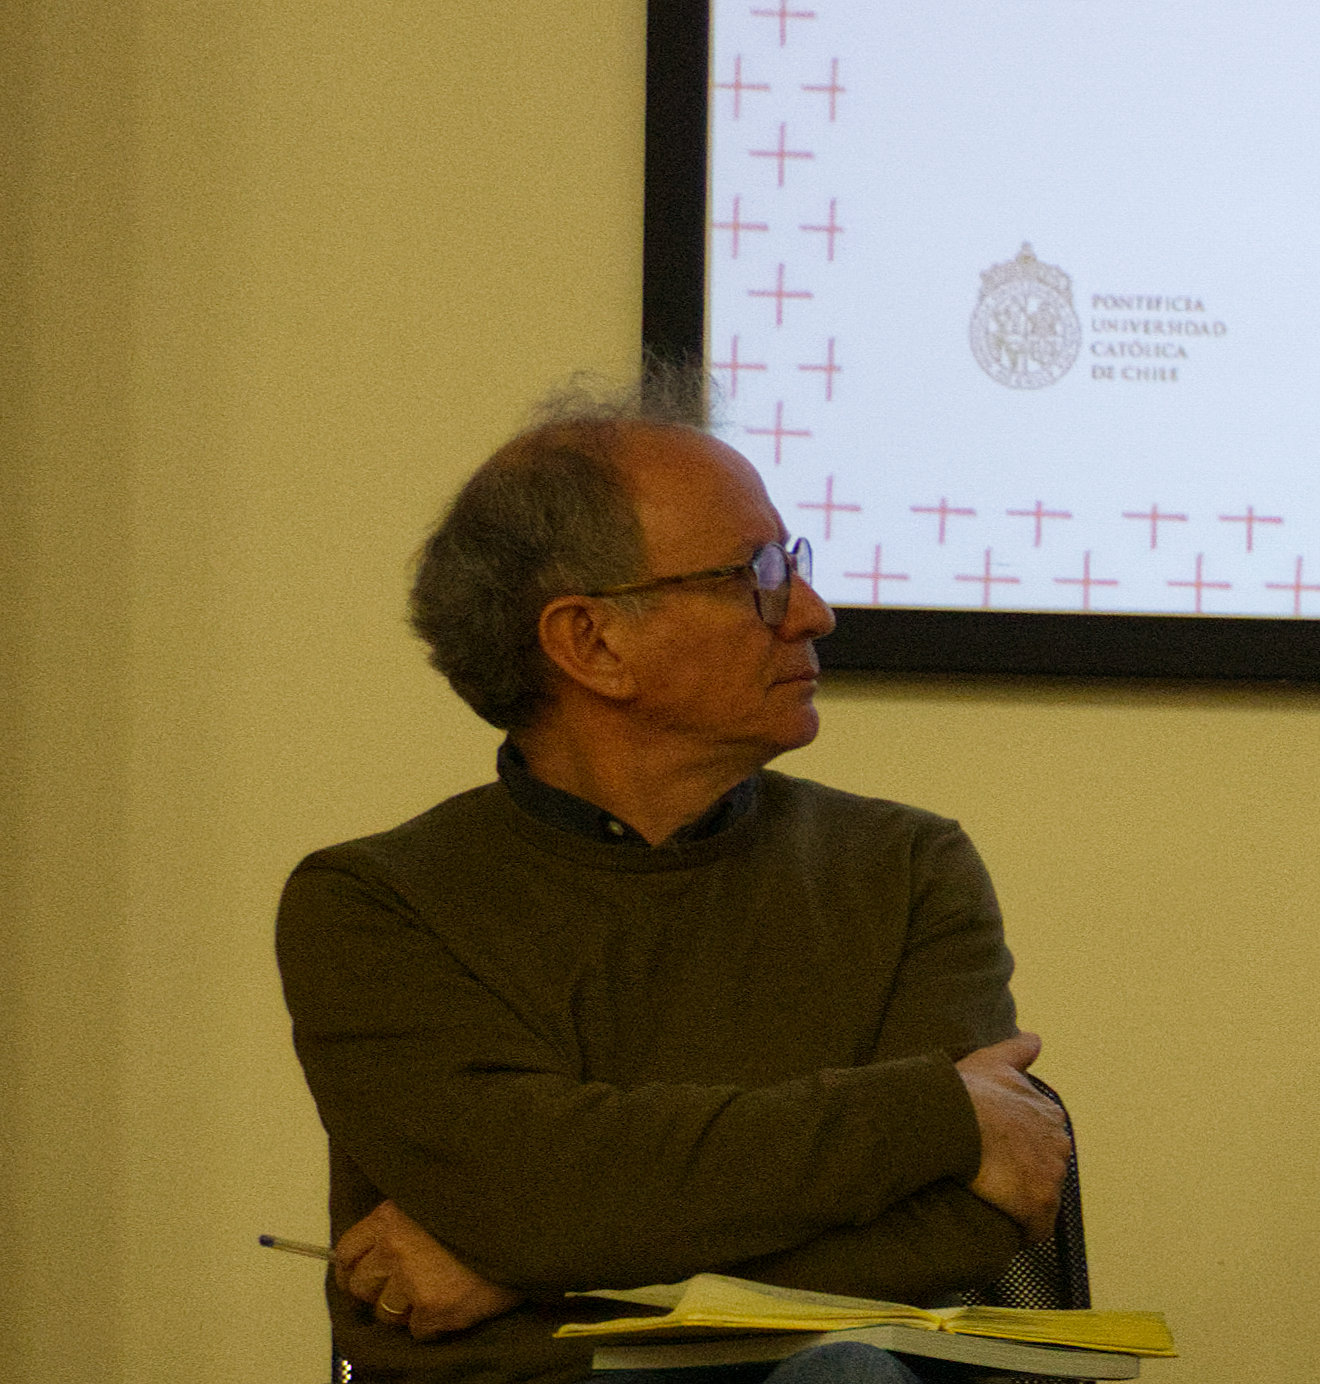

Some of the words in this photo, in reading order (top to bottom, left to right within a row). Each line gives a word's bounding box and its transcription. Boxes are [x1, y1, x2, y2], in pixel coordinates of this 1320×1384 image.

[1091, 317, 1228, 337] UNIVERSIDAD
[1091, 365, 1115, 381] DE
[1121, 366, 1179, 382] CHILE
